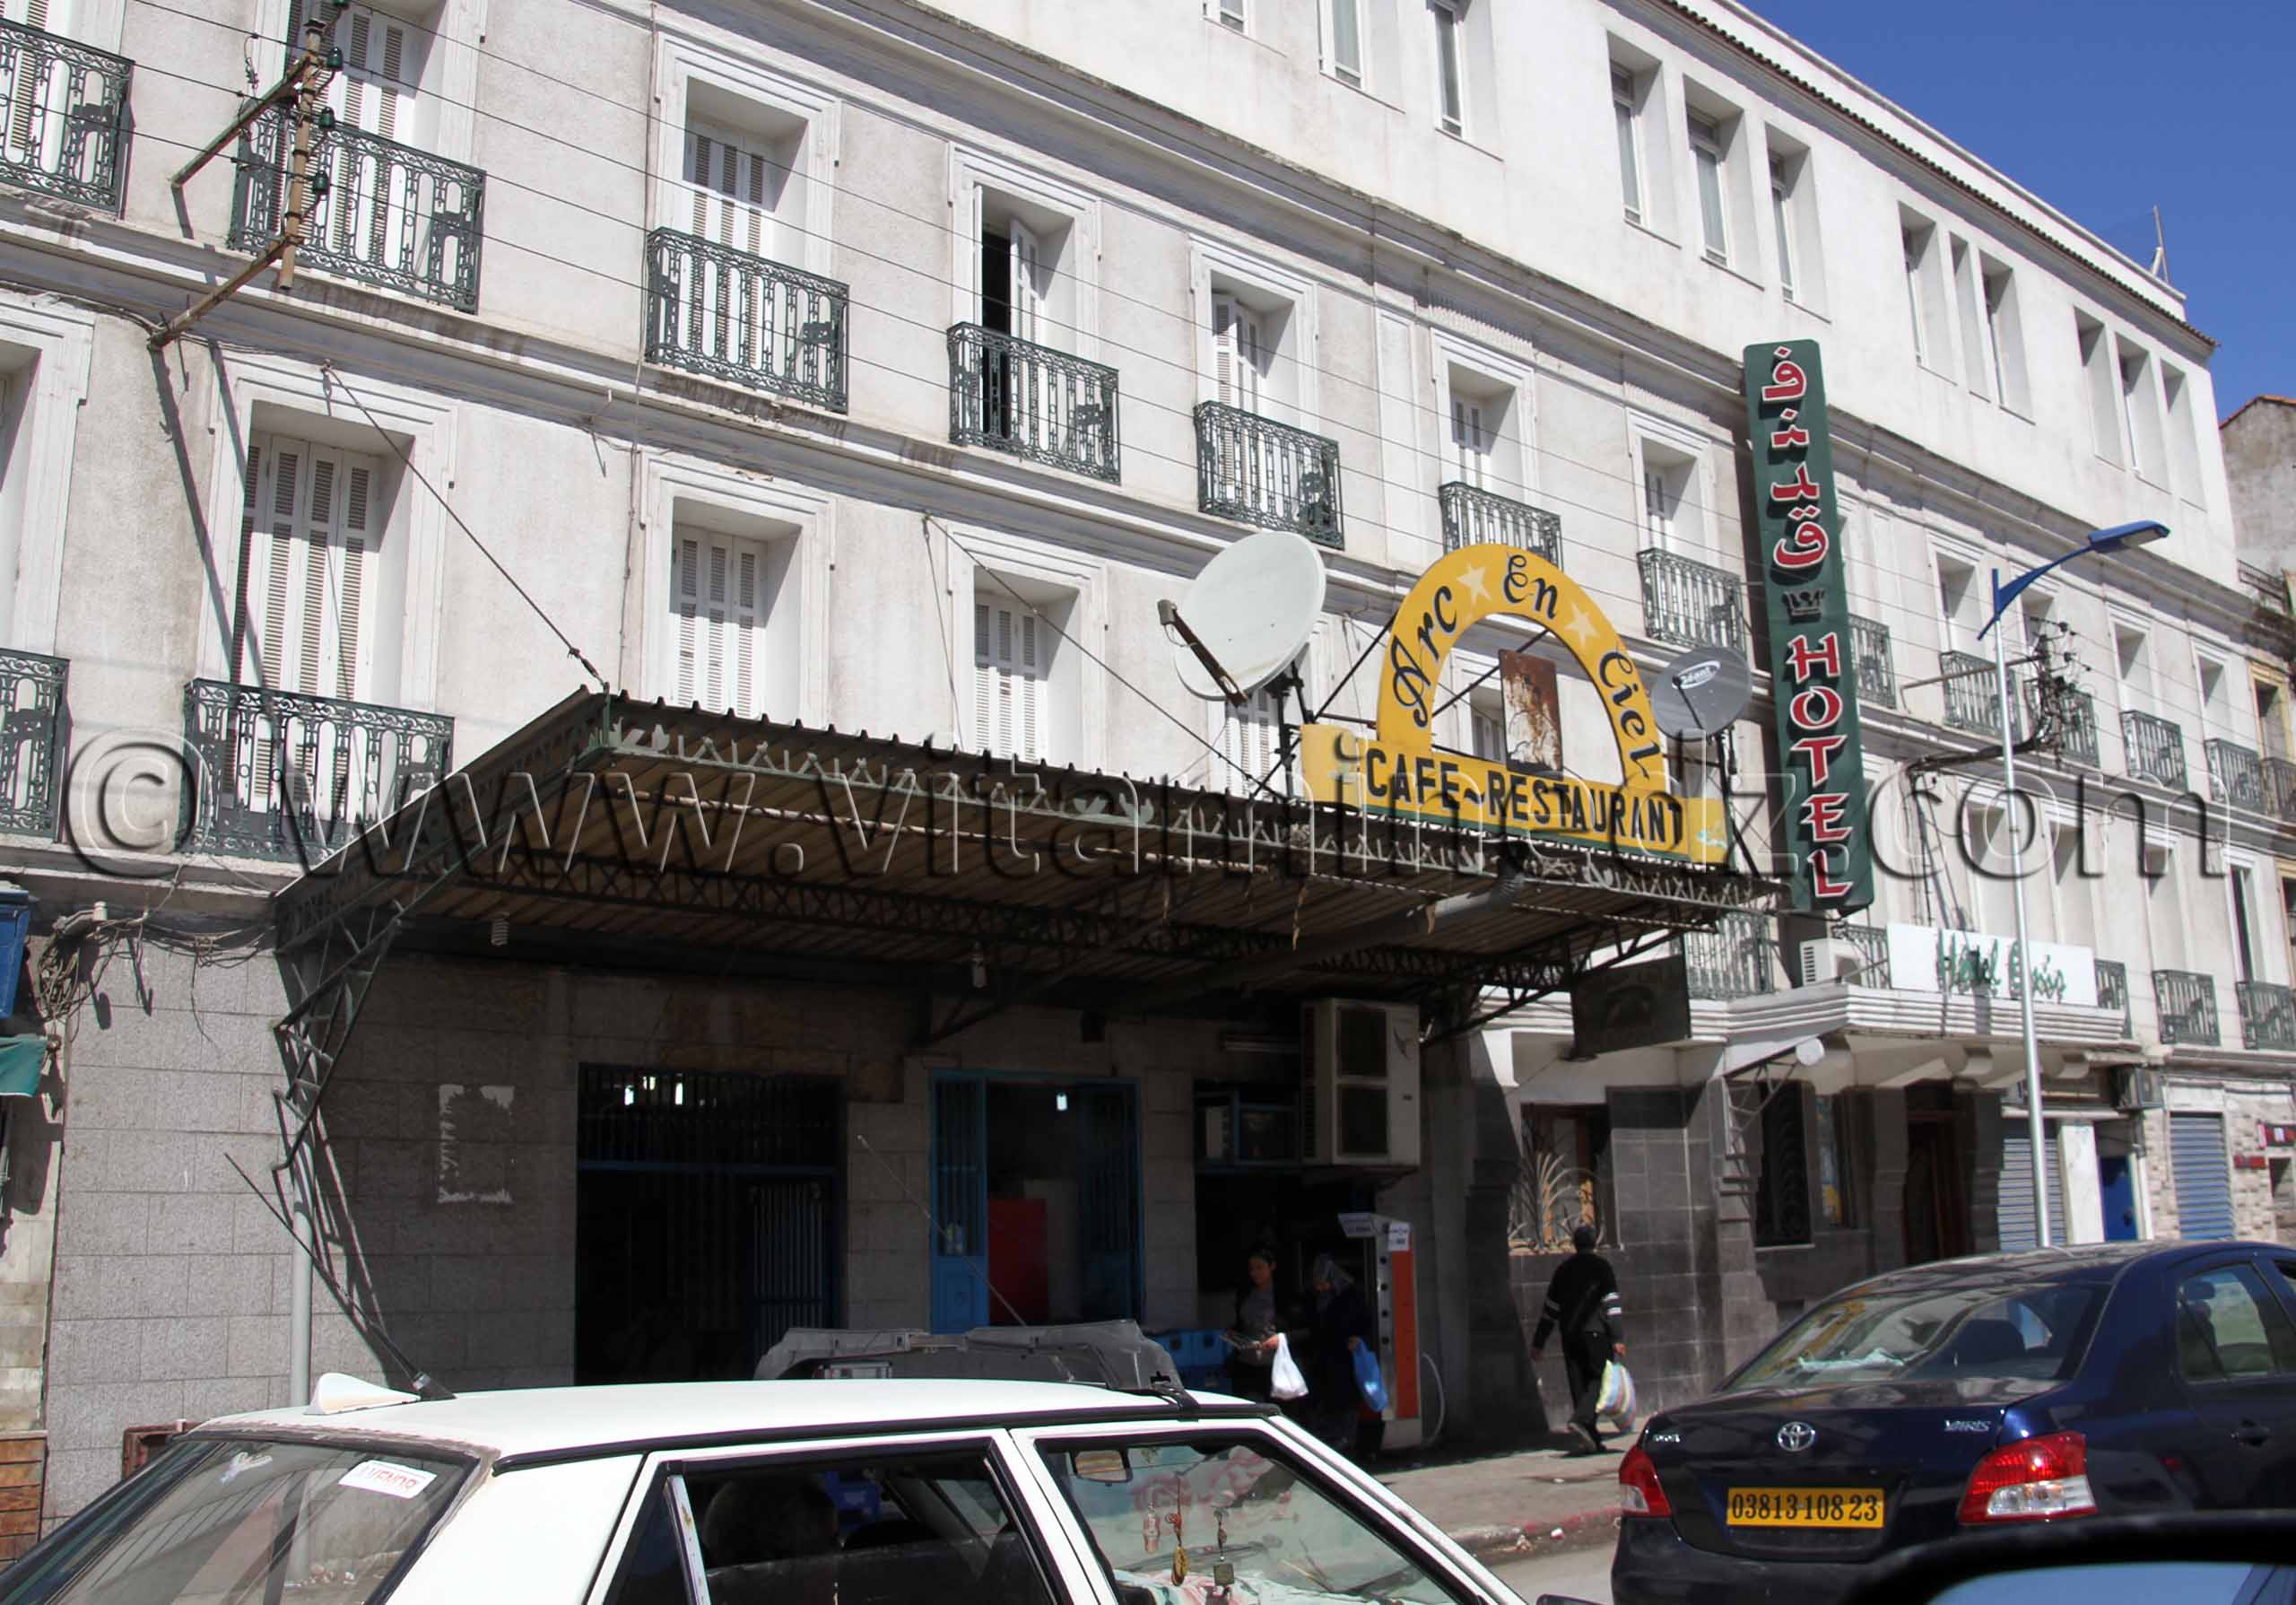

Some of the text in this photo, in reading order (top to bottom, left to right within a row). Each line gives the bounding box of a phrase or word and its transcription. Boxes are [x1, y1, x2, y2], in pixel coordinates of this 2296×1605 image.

[1761, 345, 1830, 568] فندق
[1391, 553, 1662, 782] Arc En Ciel
[1787, 630, 1854, 899] HOTEL
